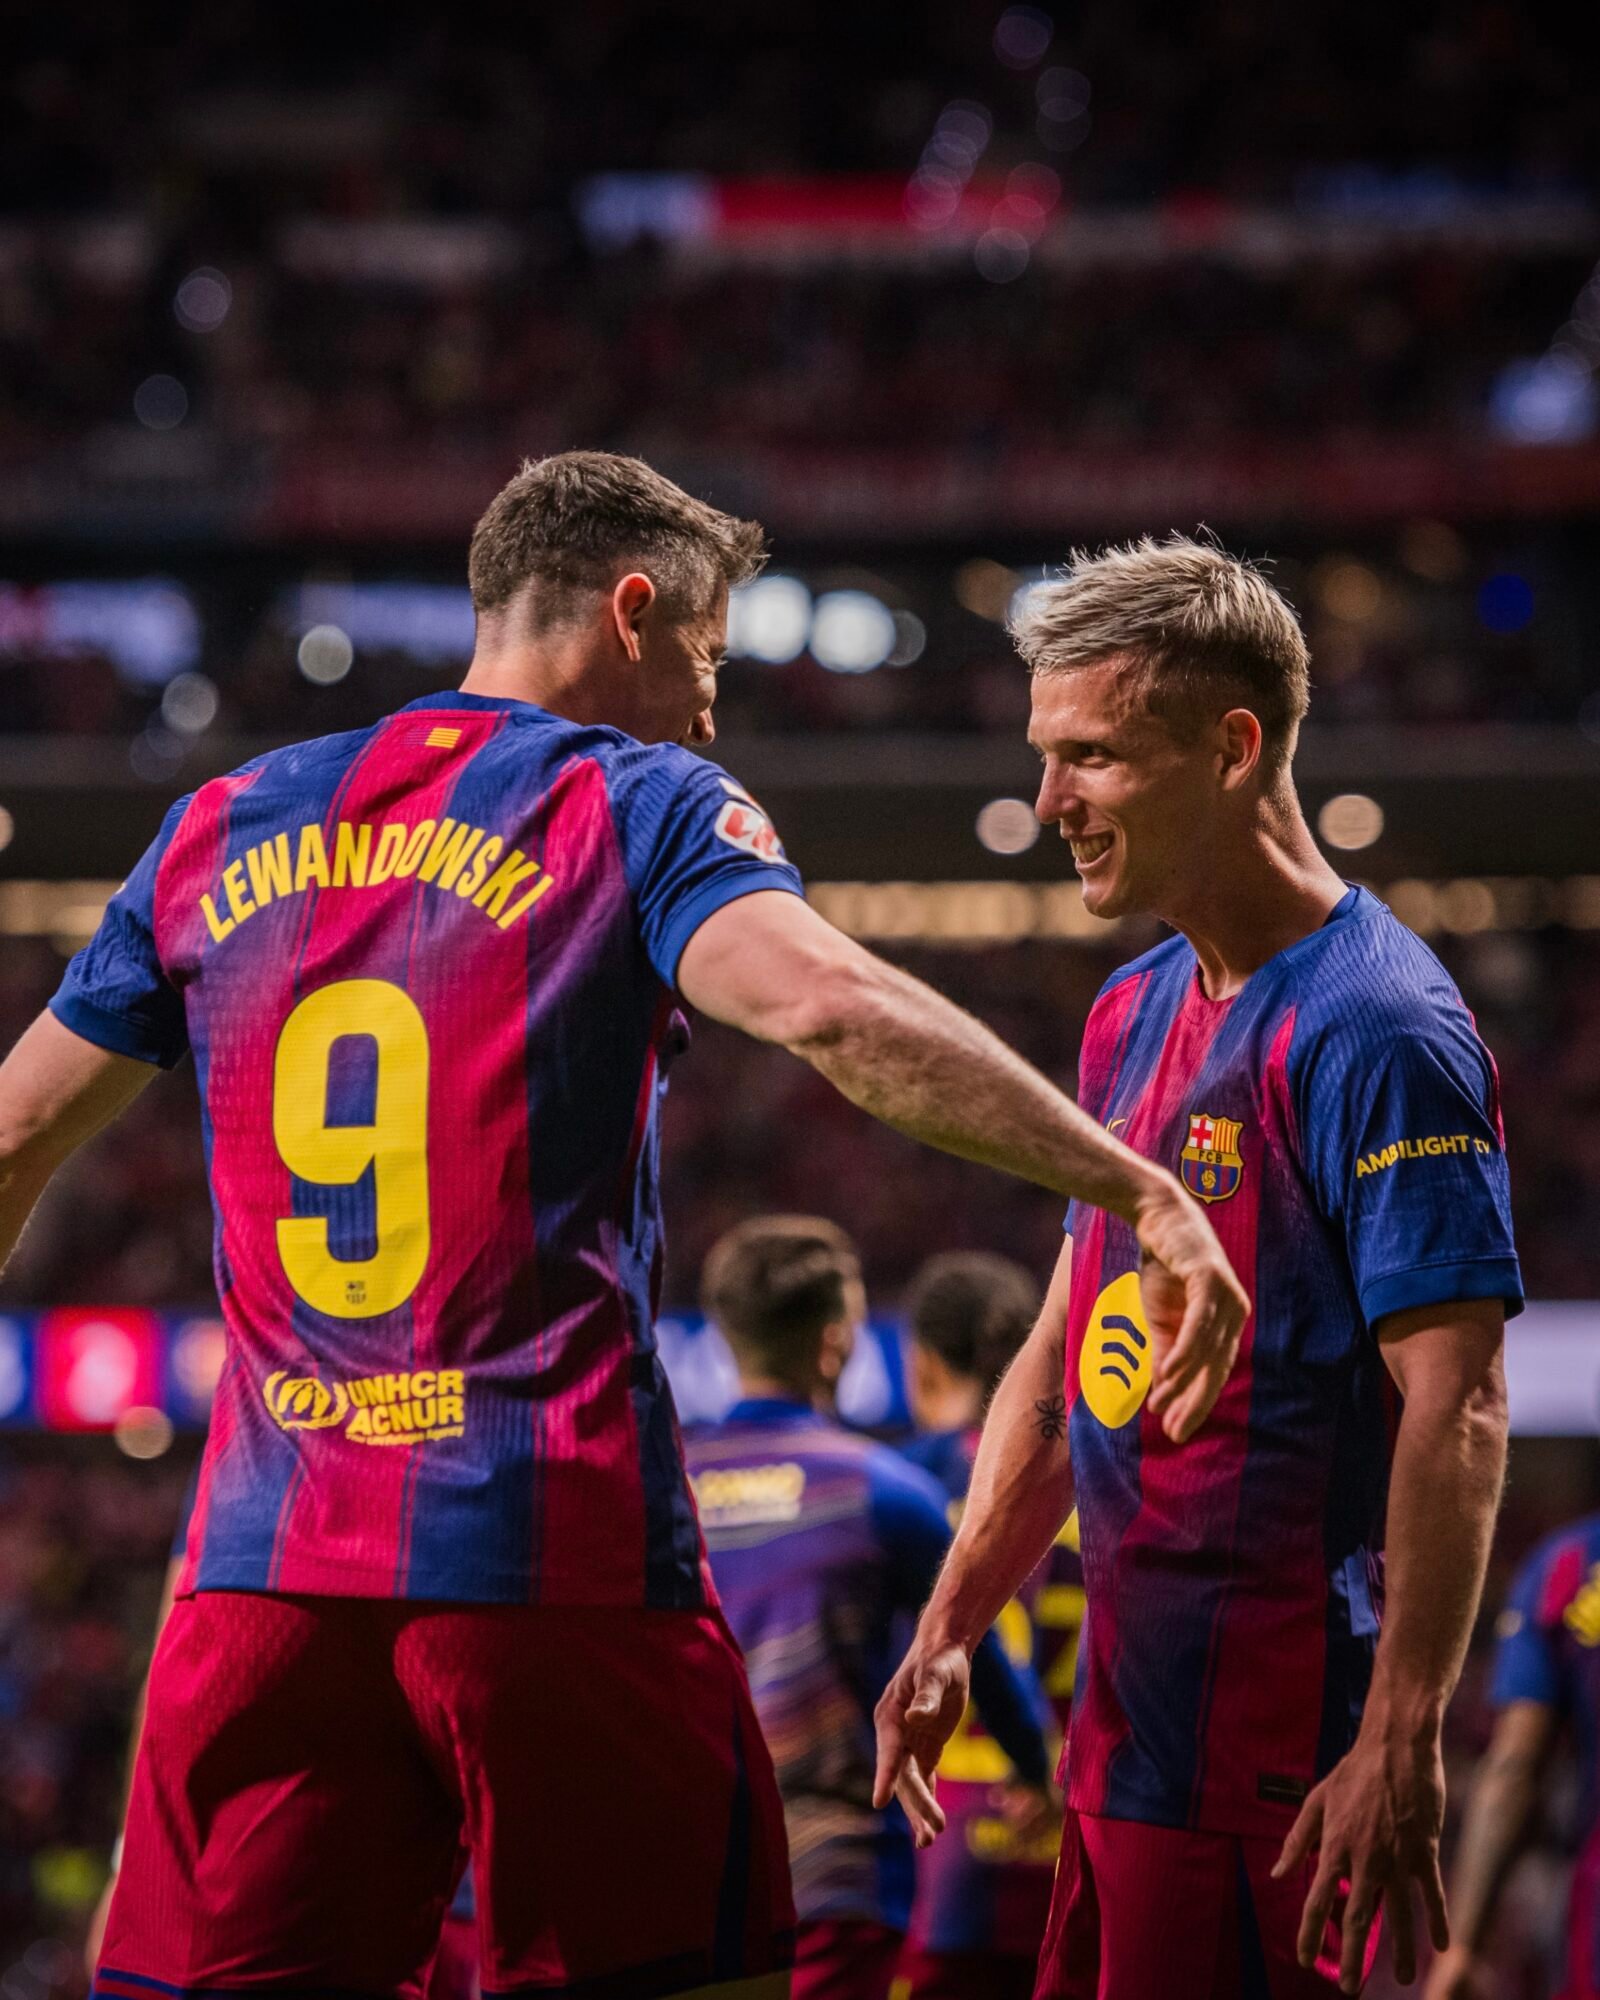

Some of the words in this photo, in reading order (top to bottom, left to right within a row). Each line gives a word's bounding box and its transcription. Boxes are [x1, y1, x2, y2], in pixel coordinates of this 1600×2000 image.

[199, 817, 554, 944] LEWANDOWSKI
[272, 979, 431, 1319] 9
[1198, 1149, 1223, 1164] FCB
[1356, 1134, 1470, 1179] AMBILIGHT
[346, 1369, 465, 1409] UNHCR
[345, 1395, 465, 1436] ACNUR
